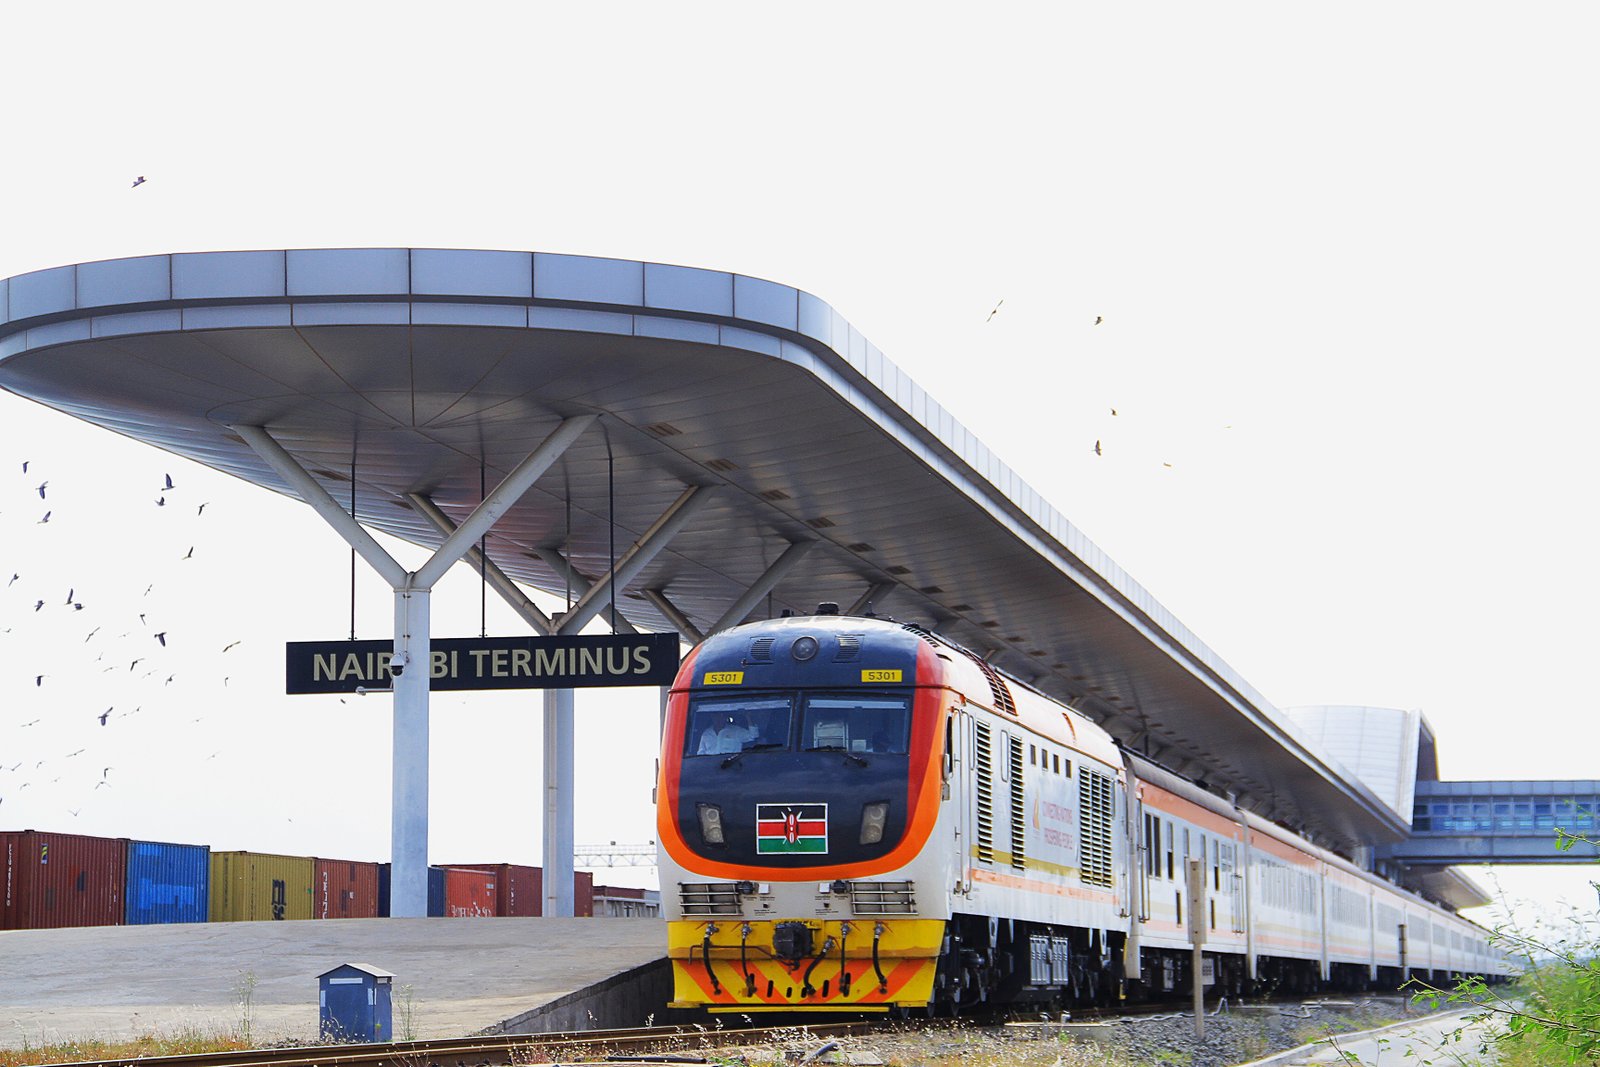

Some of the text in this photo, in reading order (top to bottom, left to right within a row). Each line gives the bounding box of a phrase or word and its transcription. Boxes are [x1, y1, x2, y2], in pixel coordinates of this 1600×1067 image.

[313, 646, 651, 682] NAIRBI TERMINUS
[710, 674, 737, 683] 5301
[868, 671, 896, 681] 5301
